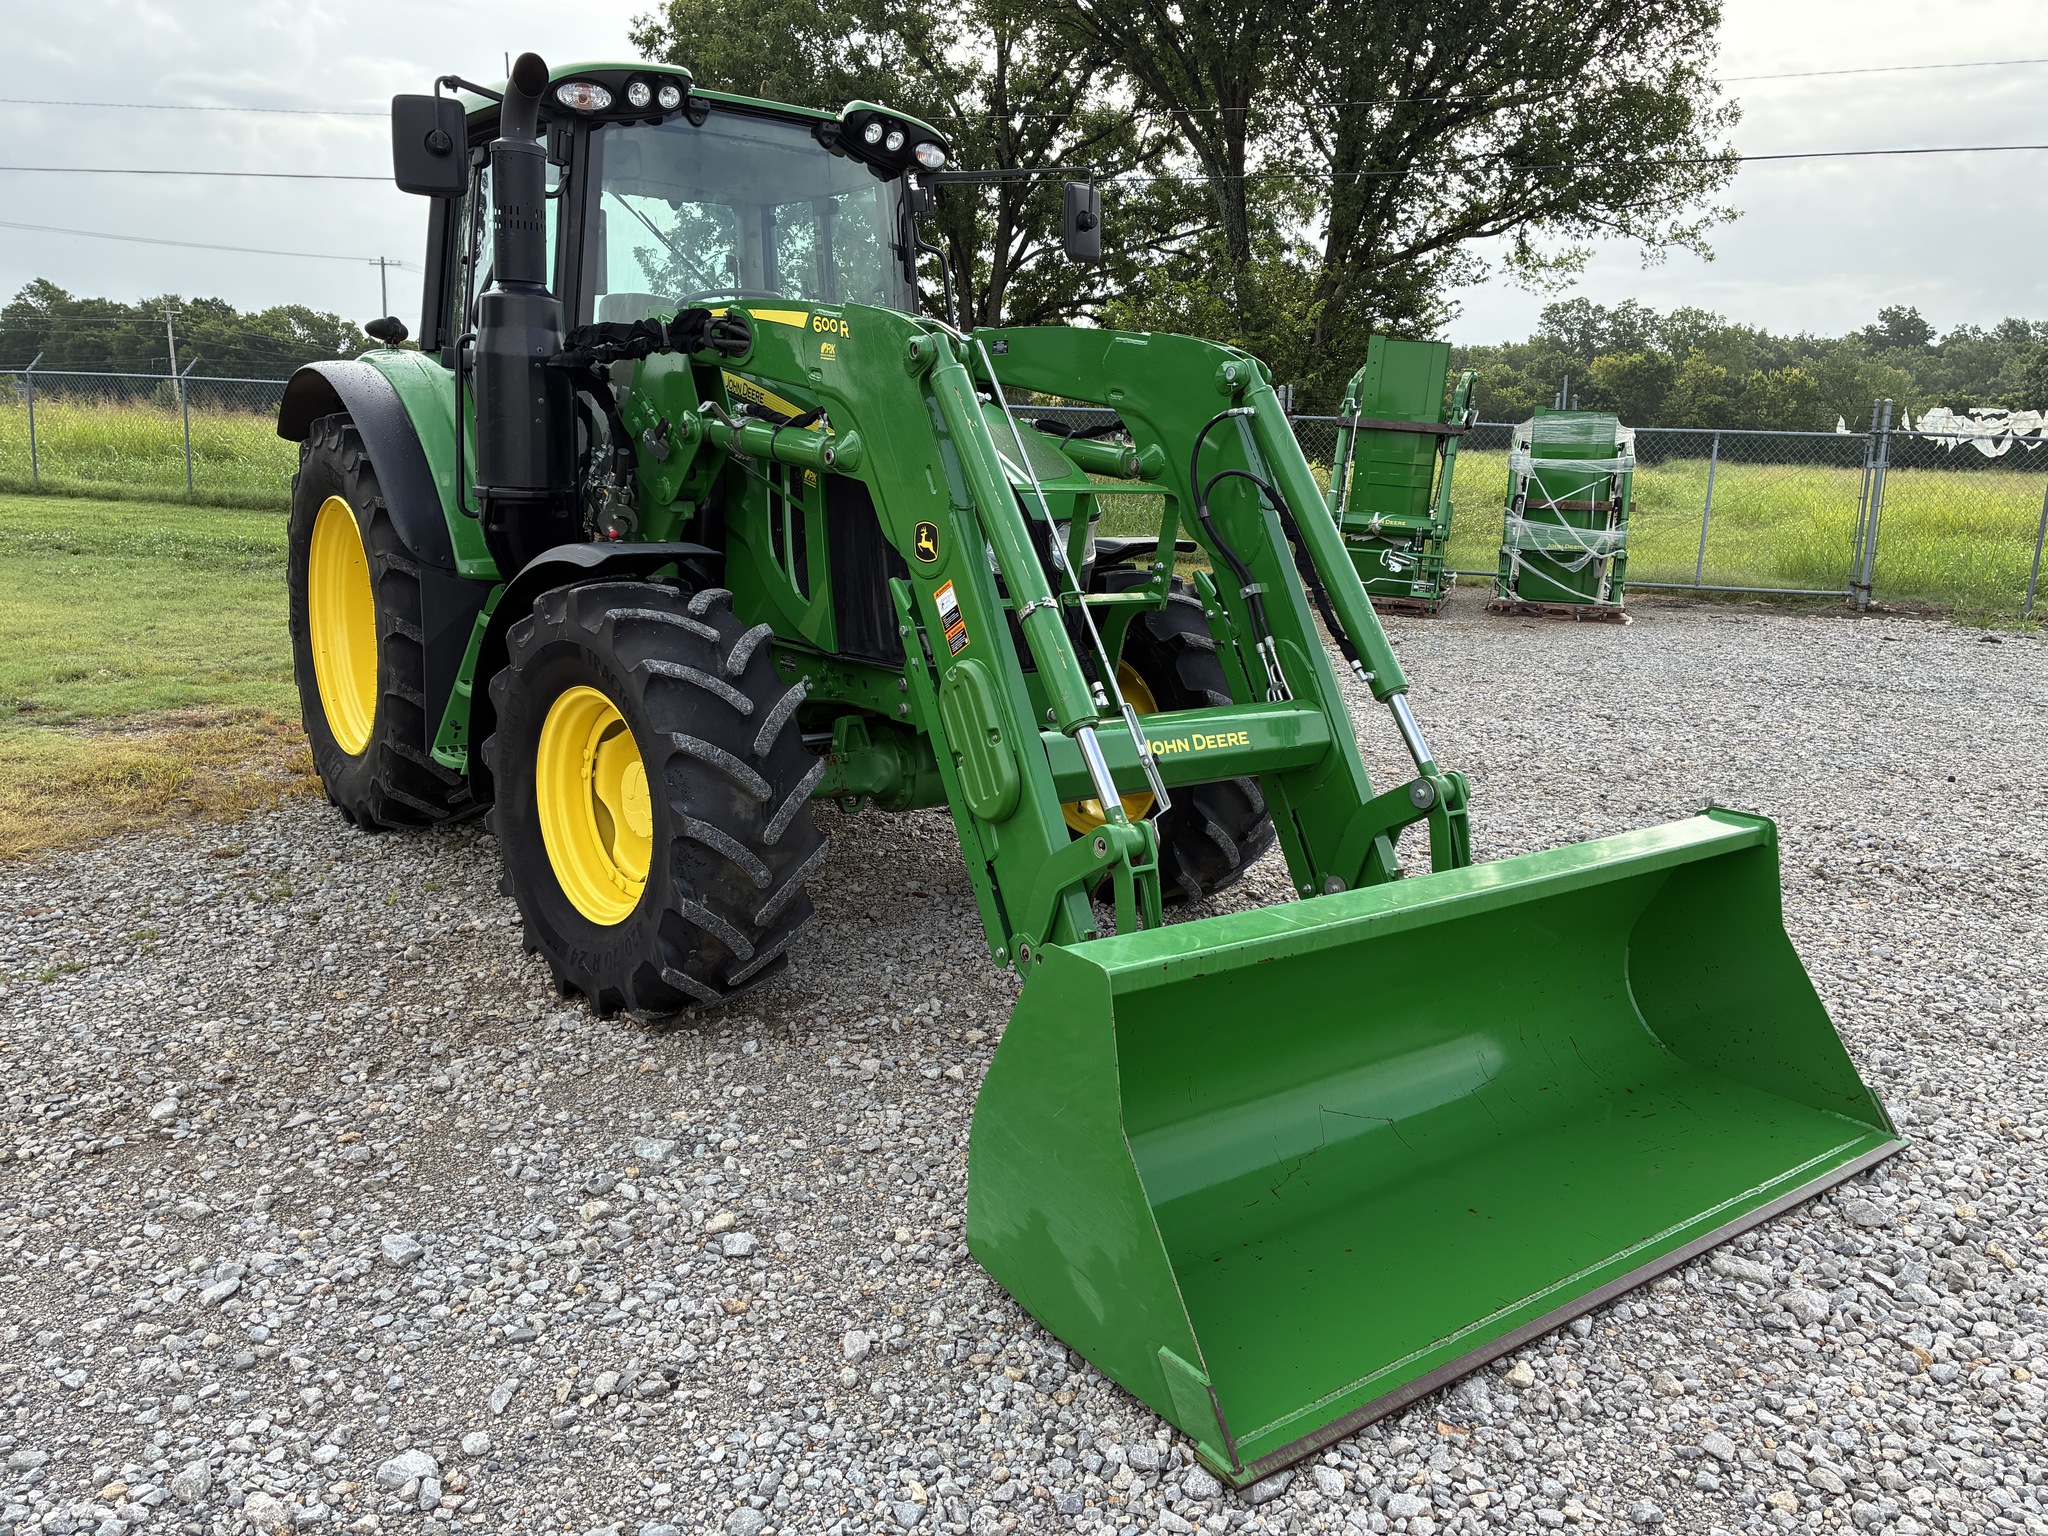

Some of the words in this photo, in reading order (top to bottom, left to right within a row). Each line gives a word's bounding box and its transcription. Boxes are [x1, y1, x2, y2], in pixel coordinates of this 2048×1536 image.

[726, 376, 742, 395] JOHN
[742, 383, 765, 404] DEERE
[1192, 731, 1250, 751] DEERE
